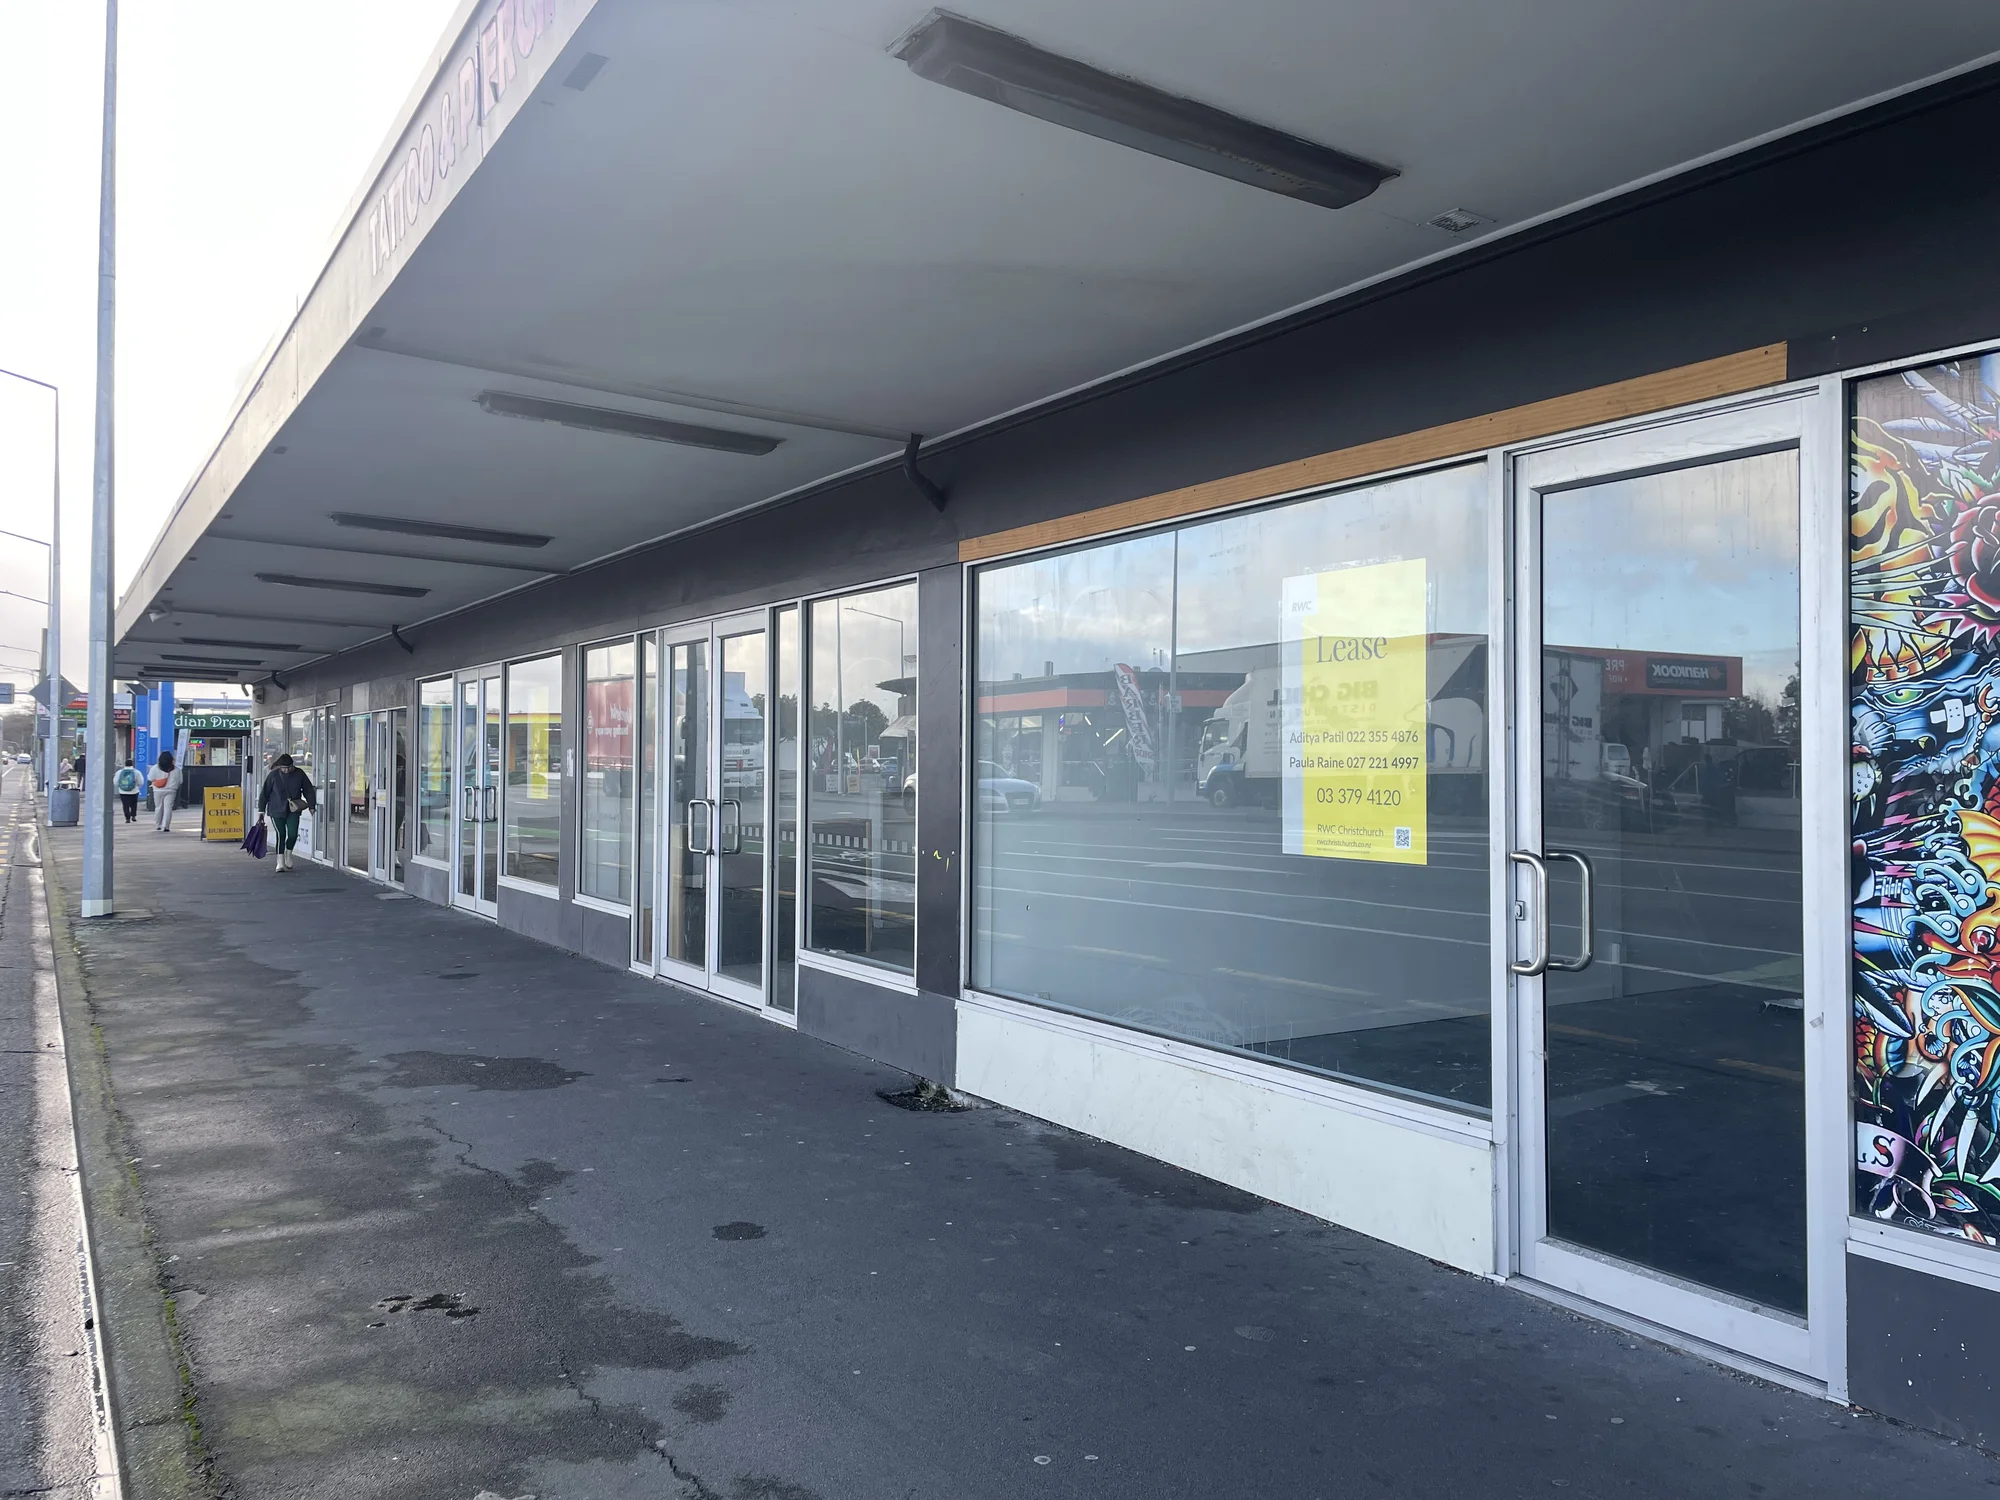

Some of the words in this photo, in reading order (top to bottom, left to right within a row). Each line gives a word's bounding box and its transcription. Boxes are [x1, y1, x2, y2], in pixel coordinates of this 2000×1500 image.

[368, 123, 435, 278] TATTOO
[438, 92, 456, 181] &
[1291, 600, 1313, 613] RWC
[1316, 634, 1388, 664] Lease
[1289, 732, 1320, 745] Aditya
[1322, 731, 1344, 743] Patil
[1346, 731, 1366, 743] 022
[1368, 731, 1388, 743] 355
[1390, 730, 1419, 743] 4876
[1289, 756, 1315, 769] Paula
[1317, 757, 1344, 769] Raine
[1346, 757, 1366, 769] 027
[1368, 757, 1388, 769] 221
[1391, 757, 1419, 769] 4997
[211, 792, 236, 800] FISH
[1316, 787, 1334, 804] 03
[1337, 788, 1363, 804] 379
[1366, 789, 1402, 806] 4120
[208, 808, 241, 817] CHIPS
[1317, 824, 1337, 834] RWC
[1338, 825, 1384, 837] Christchurch
